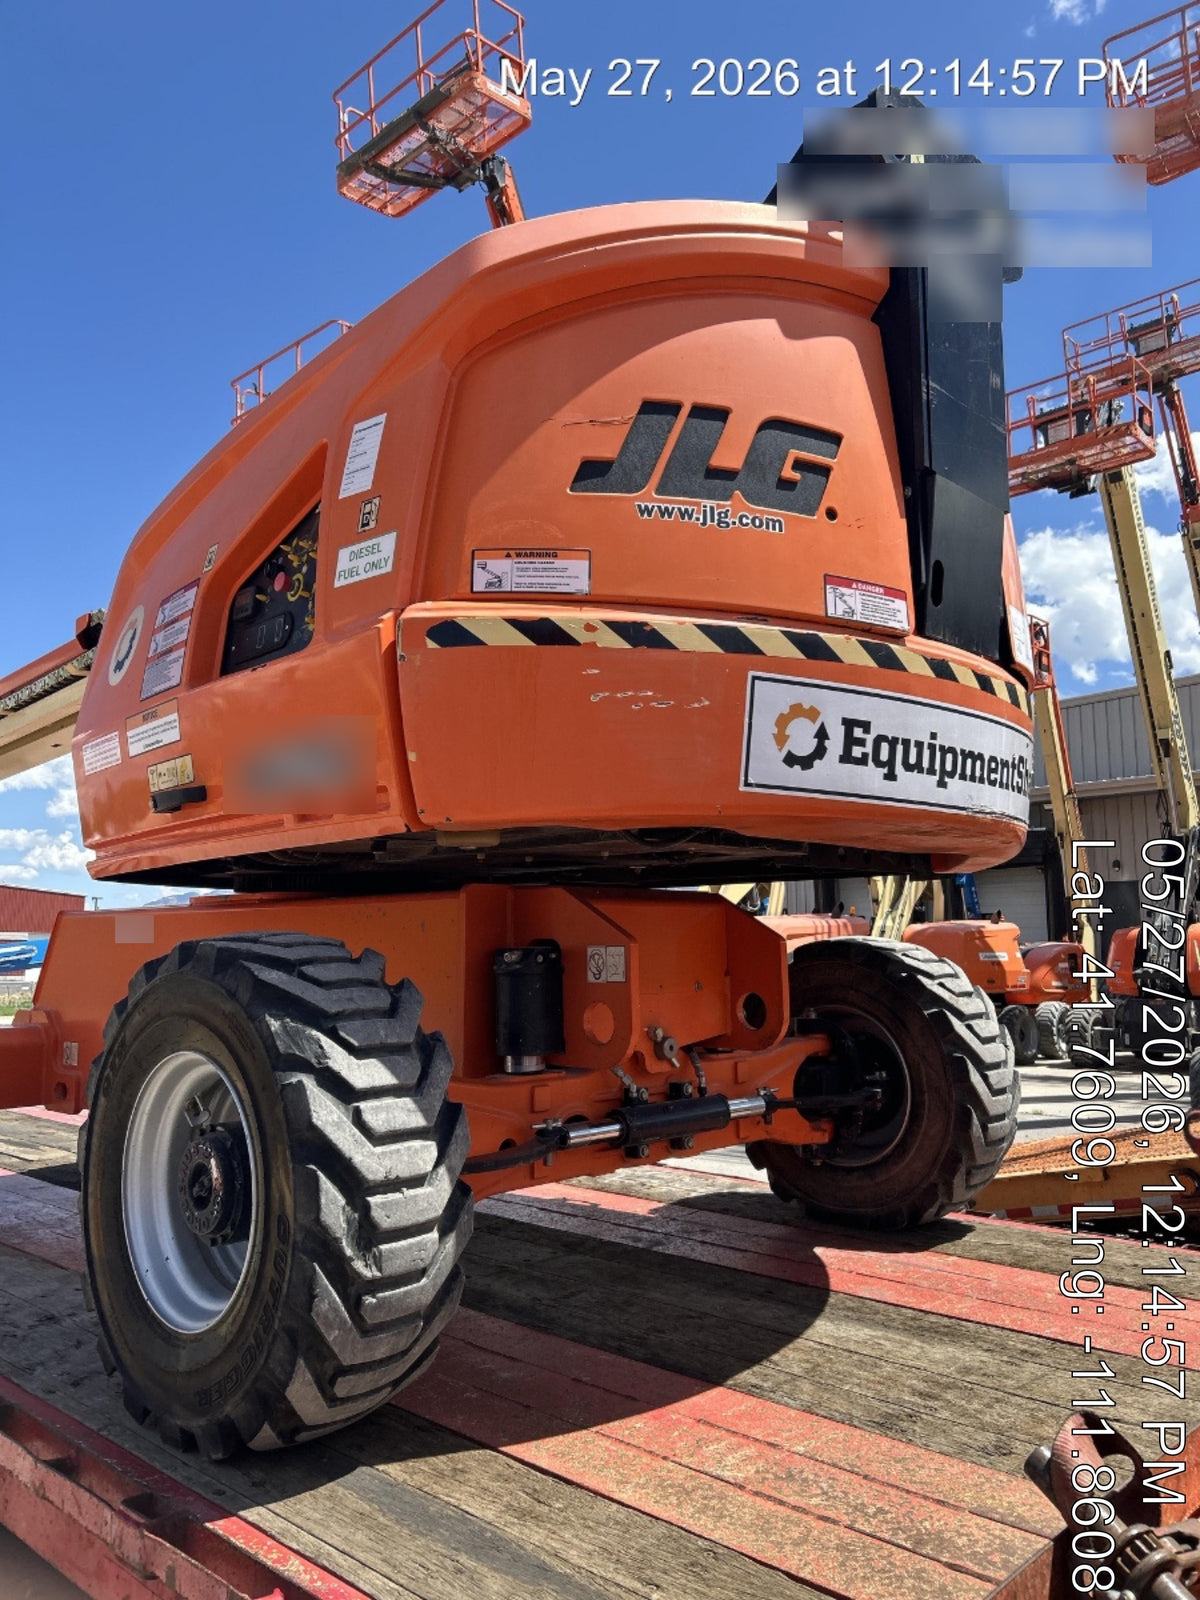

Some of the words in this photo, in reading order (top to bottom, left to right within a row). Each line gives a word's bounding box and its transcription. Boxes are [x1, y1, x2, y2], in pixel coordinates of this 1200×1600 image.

[567, 399, 844, 519] JLG
[634, 501, 786, 535] www.jlg.com
[348, 541, 382, 563] DIESEL
[514, 550, 559, 559] WARNING
[337, 564, 361, 582] FUEL
[363, 555, 390, 574] ONLY
[857, 582, 885, 595] DANGER
[838, 716, 1031, 798] EquipmentSh
[197, 1214, 290, 1407] OUTRIGGER
